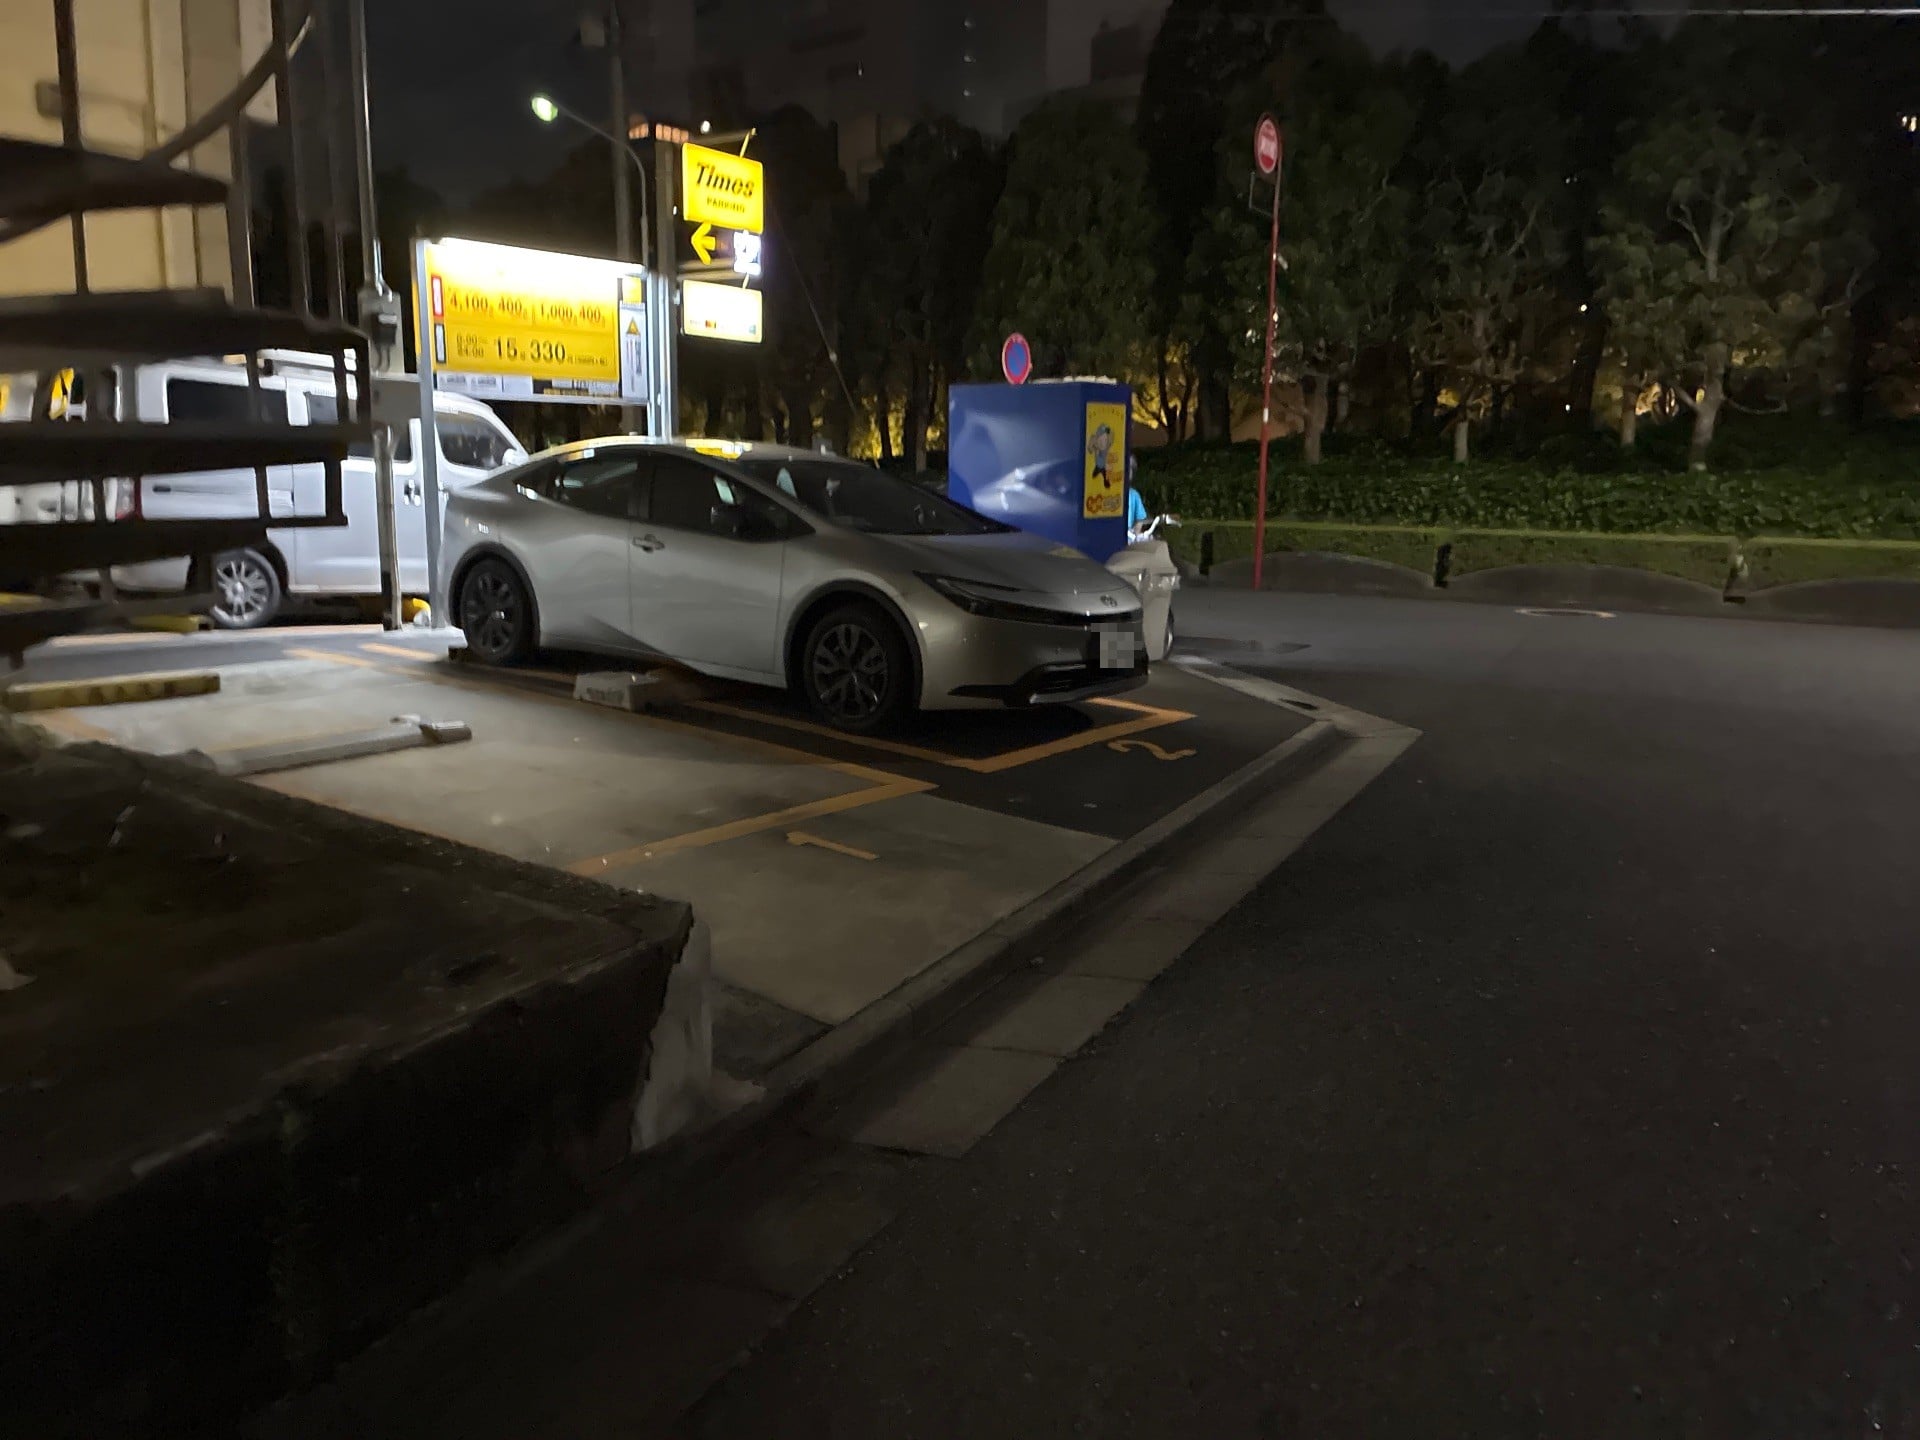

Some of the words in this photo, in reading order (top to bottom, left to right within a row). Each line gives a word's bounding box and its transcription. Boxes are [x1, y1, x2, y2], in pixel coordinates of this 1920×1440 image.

[696, 162, 755, 198] Times
[530, 339, 566, 364] 330
[1106, 738, 1199, 762] 2
[785, 830, 879, 862] 1
